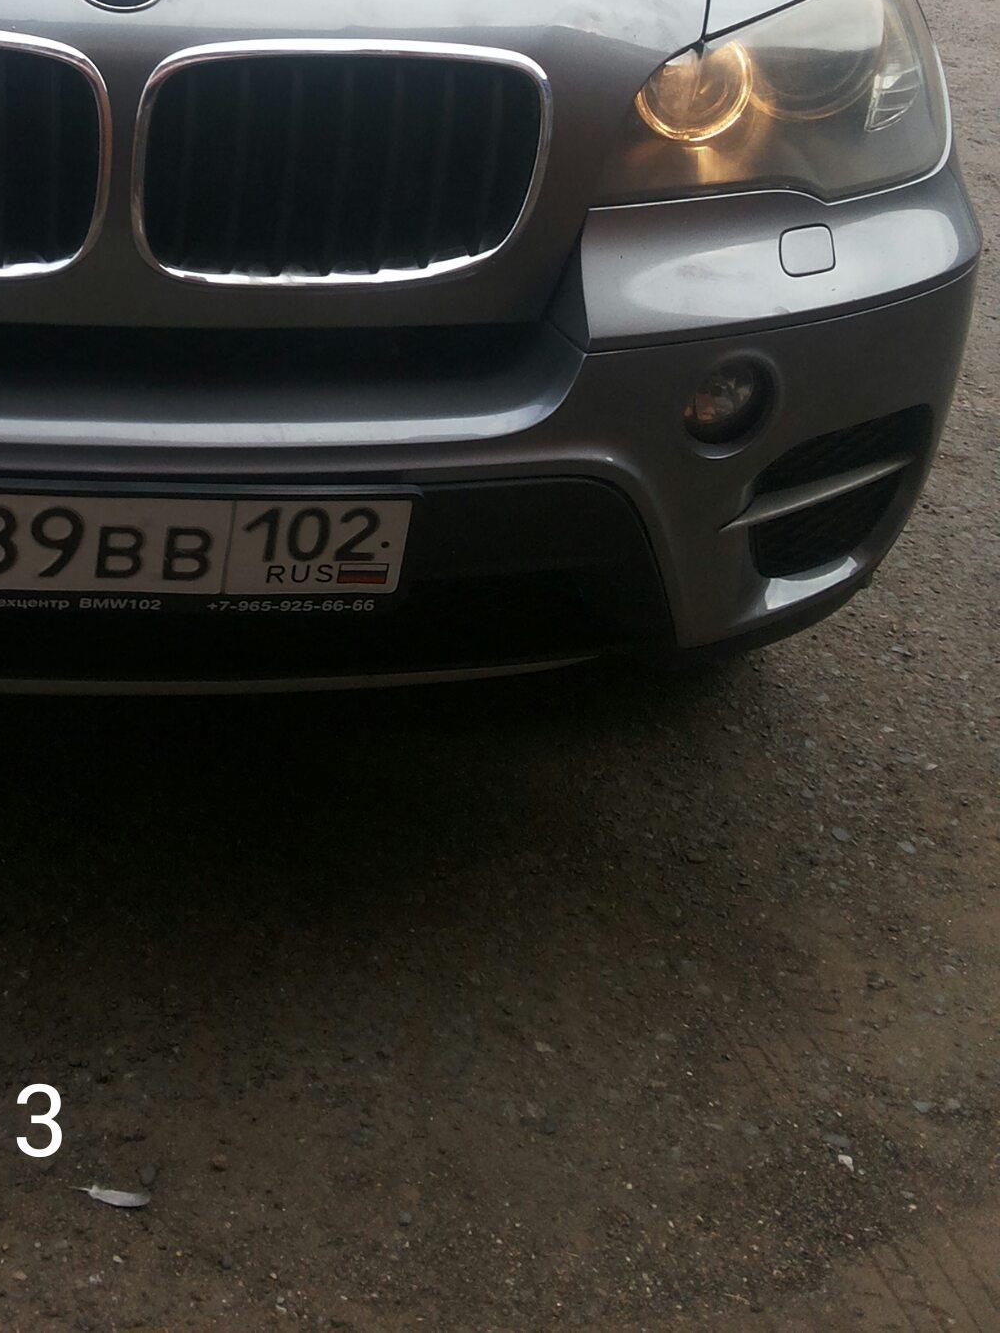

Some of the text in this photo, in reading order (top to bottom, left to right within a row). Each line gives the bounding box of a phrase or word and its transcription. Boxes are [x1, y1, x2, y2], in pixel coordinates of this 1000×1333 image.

[245, 506, 382, 563] 102
[266, 564, 334, 584] RUS
[206, 599, 376, 612] +7-965-925-66-66
